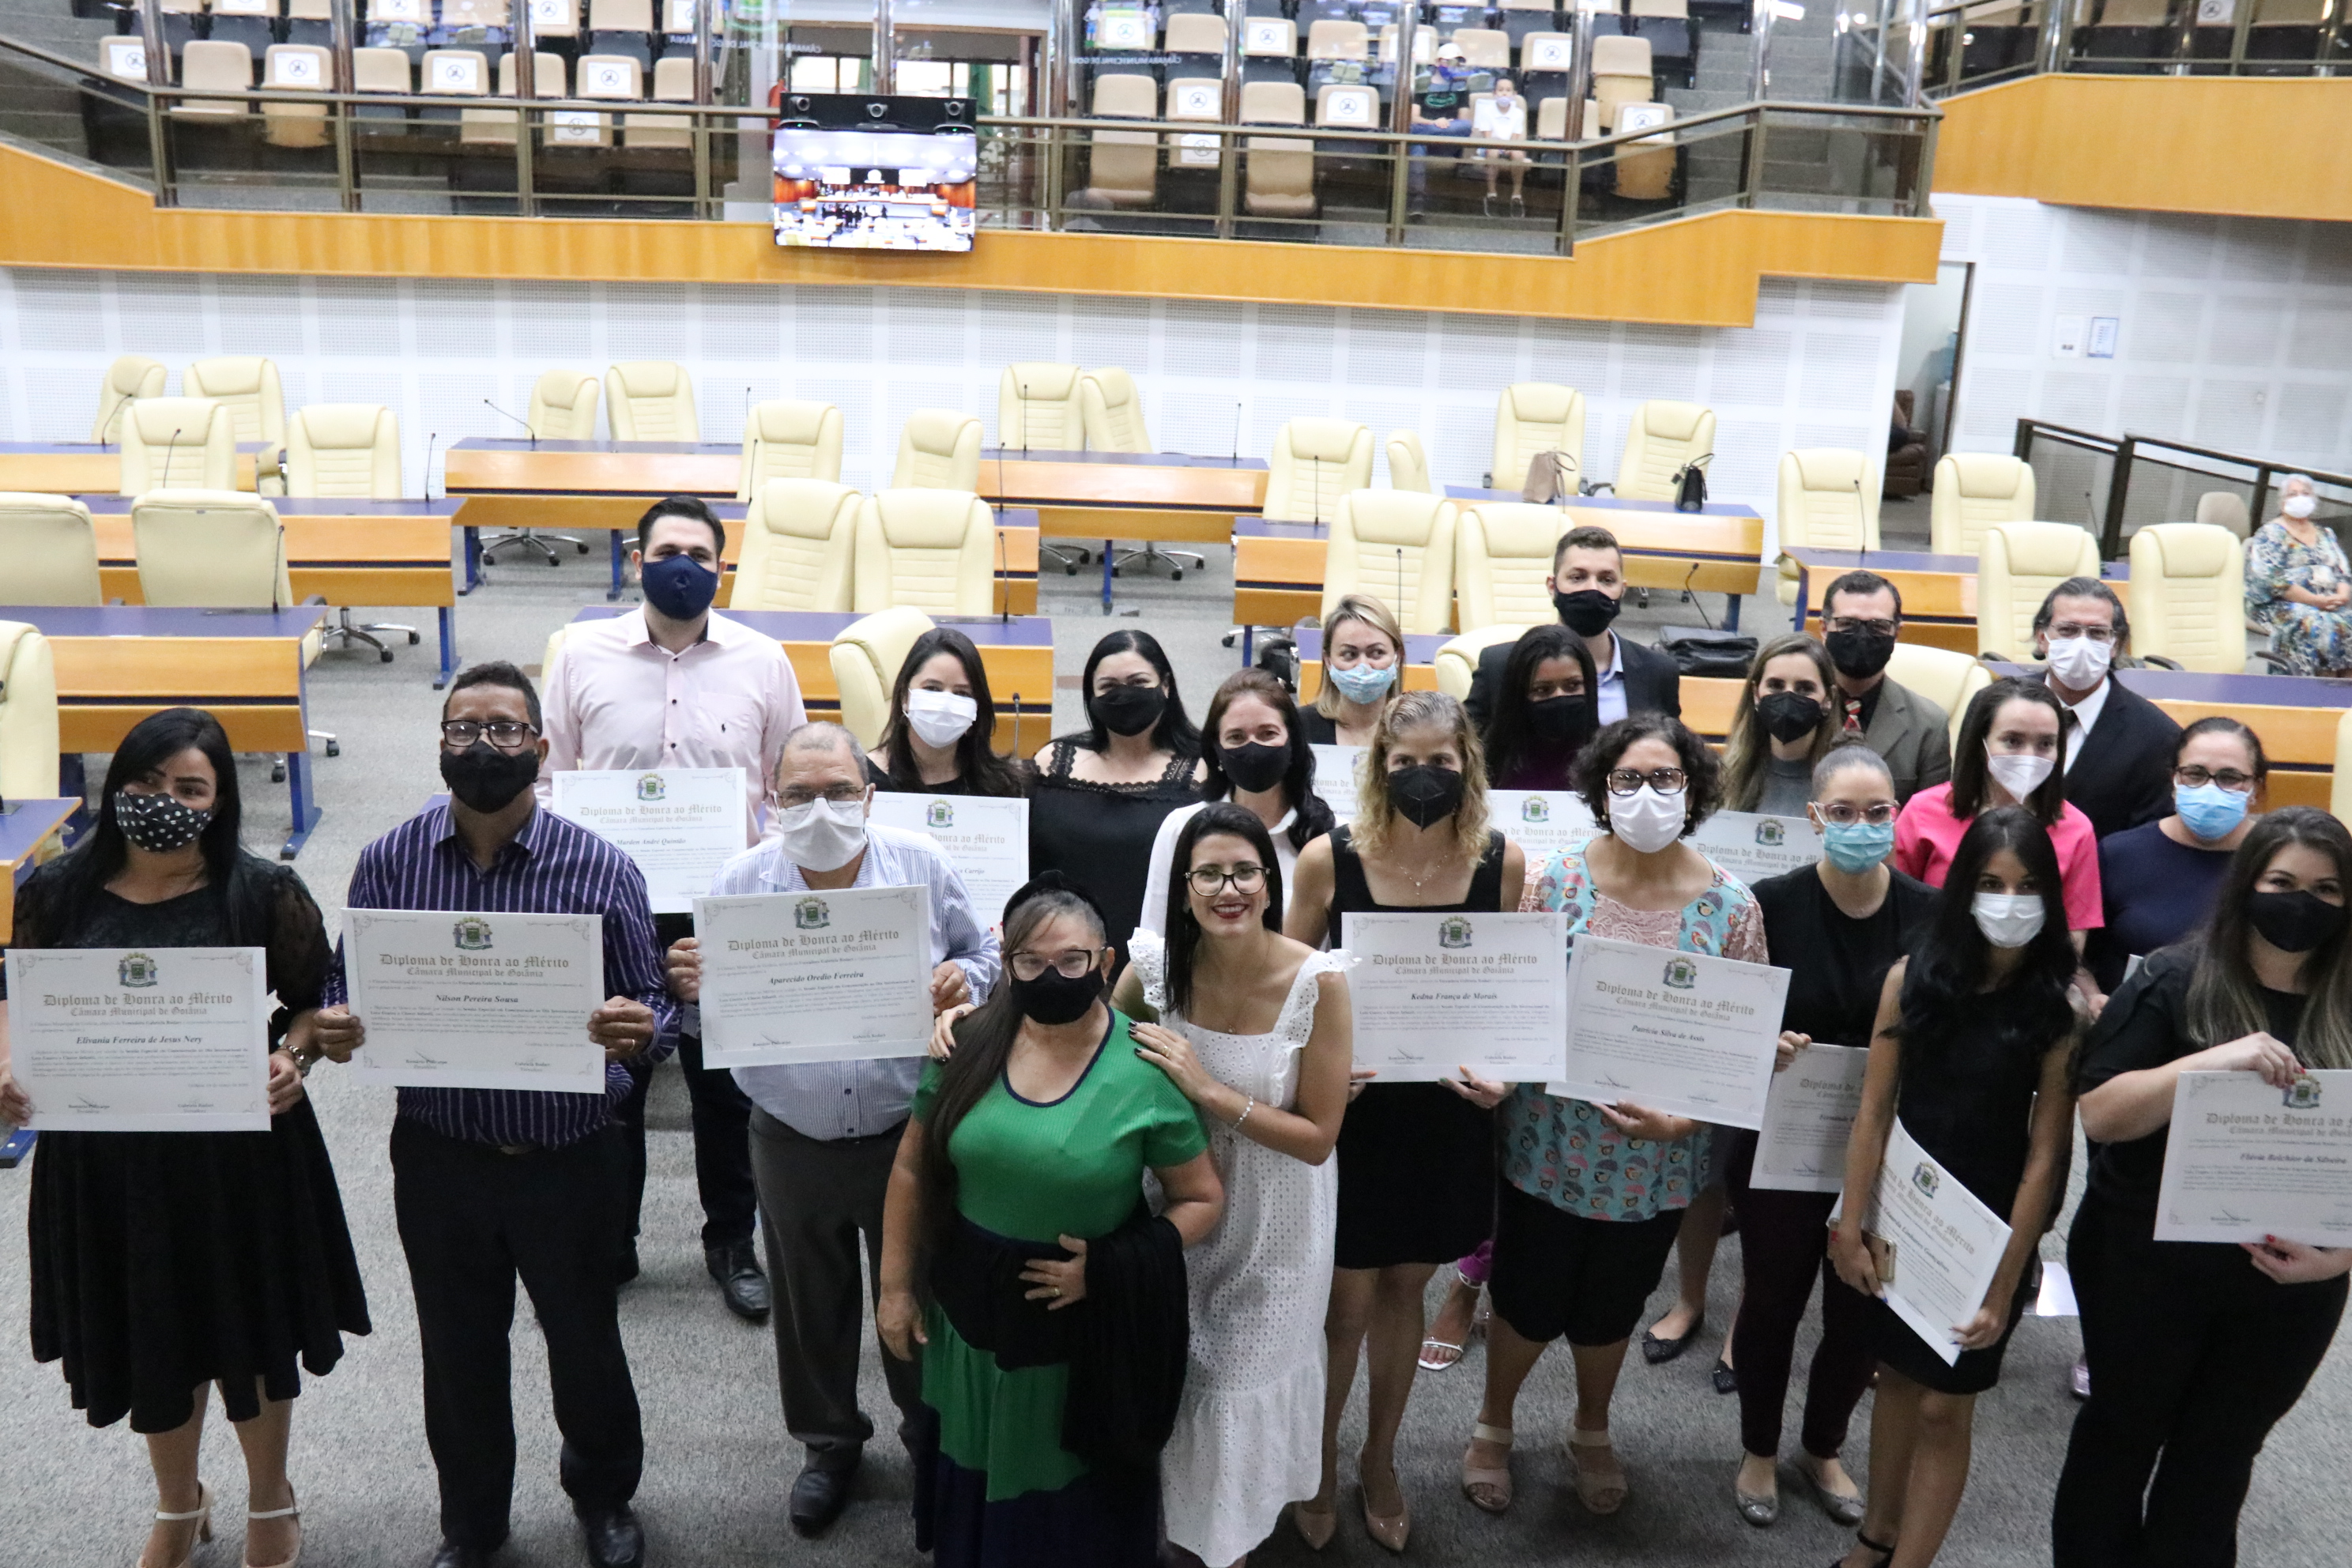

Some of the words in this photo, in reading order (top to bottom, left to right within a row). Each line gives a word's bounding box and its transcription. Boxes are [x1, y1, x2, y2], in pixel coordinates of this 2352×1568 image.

[580, 807, 622, 816] Diploma
[626, 806, 635, 815] de
[639, 805, 670, 815] Honra
[688, 804, 722, 814] Mérito
[1524, 827, 1555, 836] Honra
[974, 834, 1005, 844] Mérito
[1755, 849, 1787, 860] Honra
[727, 939, 778, 952] Diploma
[782, 936, 795, 947] de
[799, 935, 837, 946] Honra
[842, 933, 854, 943] ao
[858, 929, 899, 943] Mérito
[752, 950, 786, 959] Câmara
[788, 947, 831, 958] Municipal
[844, 944, 876, 952] Goiânia
[380, 954, 435, 968] Diploma
[440, 954, 454, 967] de
[458, 955, 500, 967] Honra
[506, 958, 520, 967] ao
[524, 956, 569, 968] Mérito
[1372, 954, 1421, 966] Diploma
[1426, 955, 1437, 965] de
[1442, 953, 1478, 964] Honra
[1498, 953, 1537, 965] Mérito
[447, 968, 492, 978] Municipal
[508, 969, 544, 978] Goiânia
[1395, 966, 1427, 974] Câmara
[1429, 967, 1469, 975] Municipal
[768, 975, 805, 986] Aparecido
[834, 971, 865, 979] Ferreira
[43, 994, 100, 1007] Diploma
[104, 994, 119, 1005] de
[123, 993, 164, 1005] Honra
[170, 996, 183, 1005] ao
[189, 993, 232, 1004] Mérito
[435, 994, 462, 1003] Nilson
[1435, 993, 1461, 1001] França
[1596, 981, 1642, 999] Diploma
[1646, 989, 1659, 1001] de
[1663, 990, 1698, 1006] Honra
[1701, 999, 1713, 1009] ao
[1717, 1000, 1755, 1016] Mérito
[71, 1007, 107, 1017] Câmara
[110, 1007, 156, 1017] Municipal
[159, 1007, 171, 1016] de
[172, 1006, 207, 1016] Goiânia
[1617, 997, 1646, 1009] Câmara
[1648, 1002, 1688, 1016] Municipal
[1689, 1007, 1698, 1016] de
[1700, 1009, 1731, 1022] Goiânia
[1659, 1028, 1677, 1038] Silva
[159, 1035, 182, 1044] Jesus
[185, 1035, 202, 1045] Nery
[2206, 1113, 2259, 1125] Diploma
[2263, 1114, 2276, 1125] de
[2282, 1114, 2324, 1125] Honra
